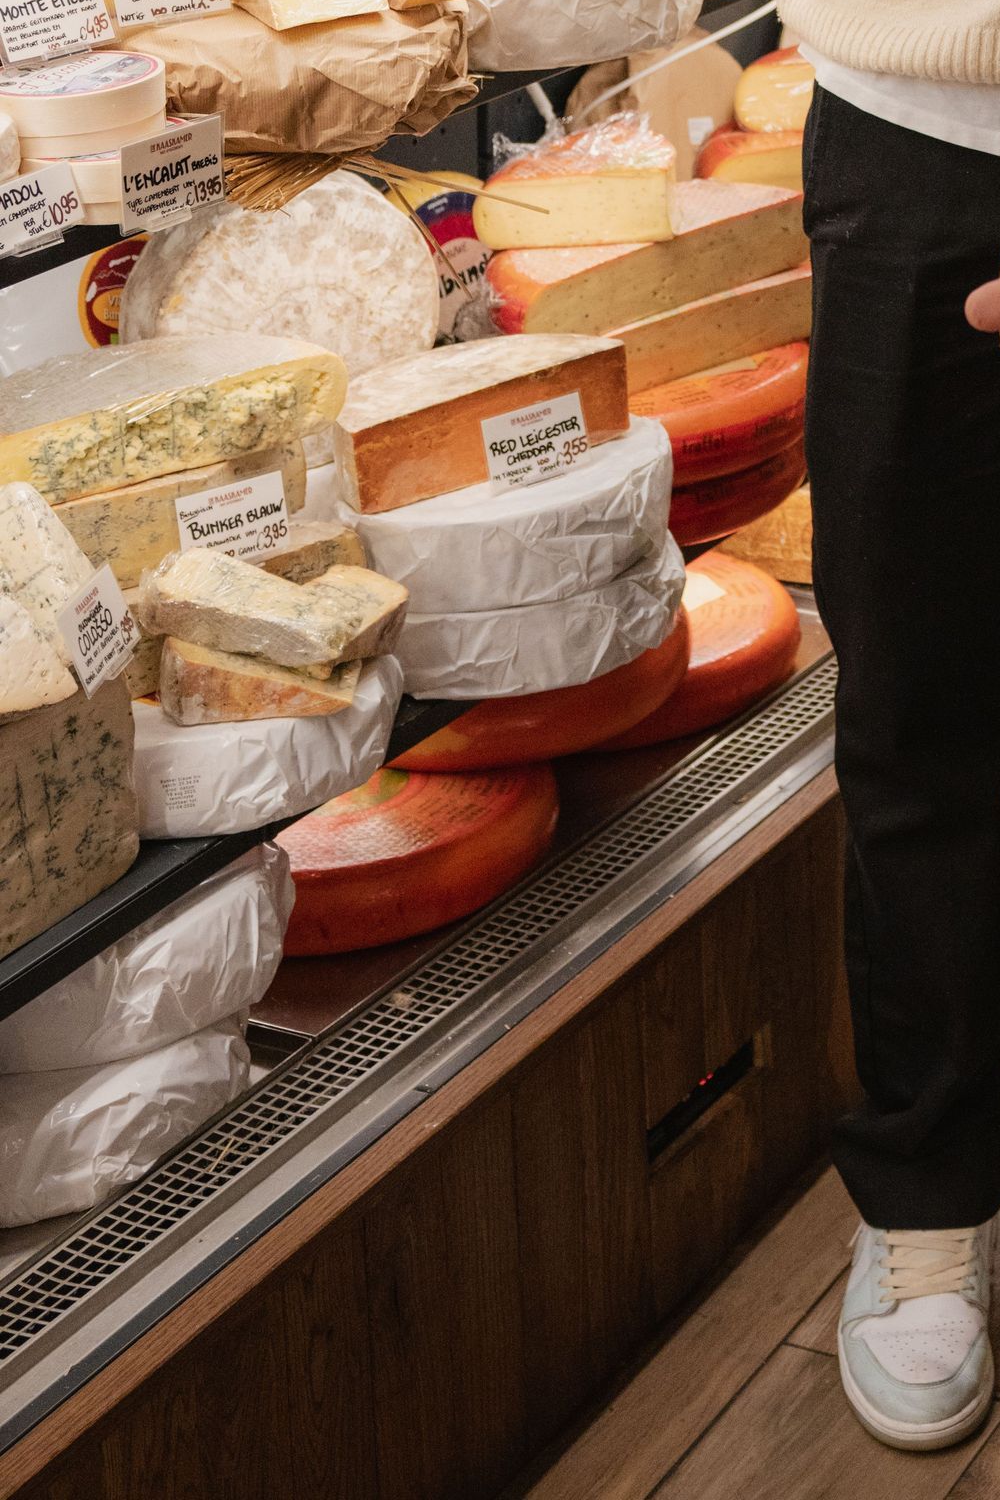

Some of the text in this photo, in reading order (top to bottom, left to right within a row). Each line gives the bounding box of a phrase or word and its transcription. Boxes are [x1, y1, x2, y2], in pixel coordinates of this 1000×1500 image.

[3, 23, 28, 34] SPAANSE
[30, 12, 65, 27] GEITENKAAS
[150, 6, 168, 16] 100
[156, 132, 192, 150] KAASKAMER
[124, 155, 191, 193] L'ENCALAT
[8, 198, 46, 222] CAMEMBERT
[126, 198, 144, 212] TYPE
[144, 184, 180, 204] CAMEMBERT
[136, 197, 177, 216] SCHAPENMELK
[24, 218, 36, 230] PER
[28, 225, 44, 236] STUK
[490, 416, 580, 458] RED LEICESTER
[507, 442, 556, 466] CHEDDAR
[187, 498, 284, 540] BUNKER BLAUW
[78, 608, 113, 657] COLOSSO
